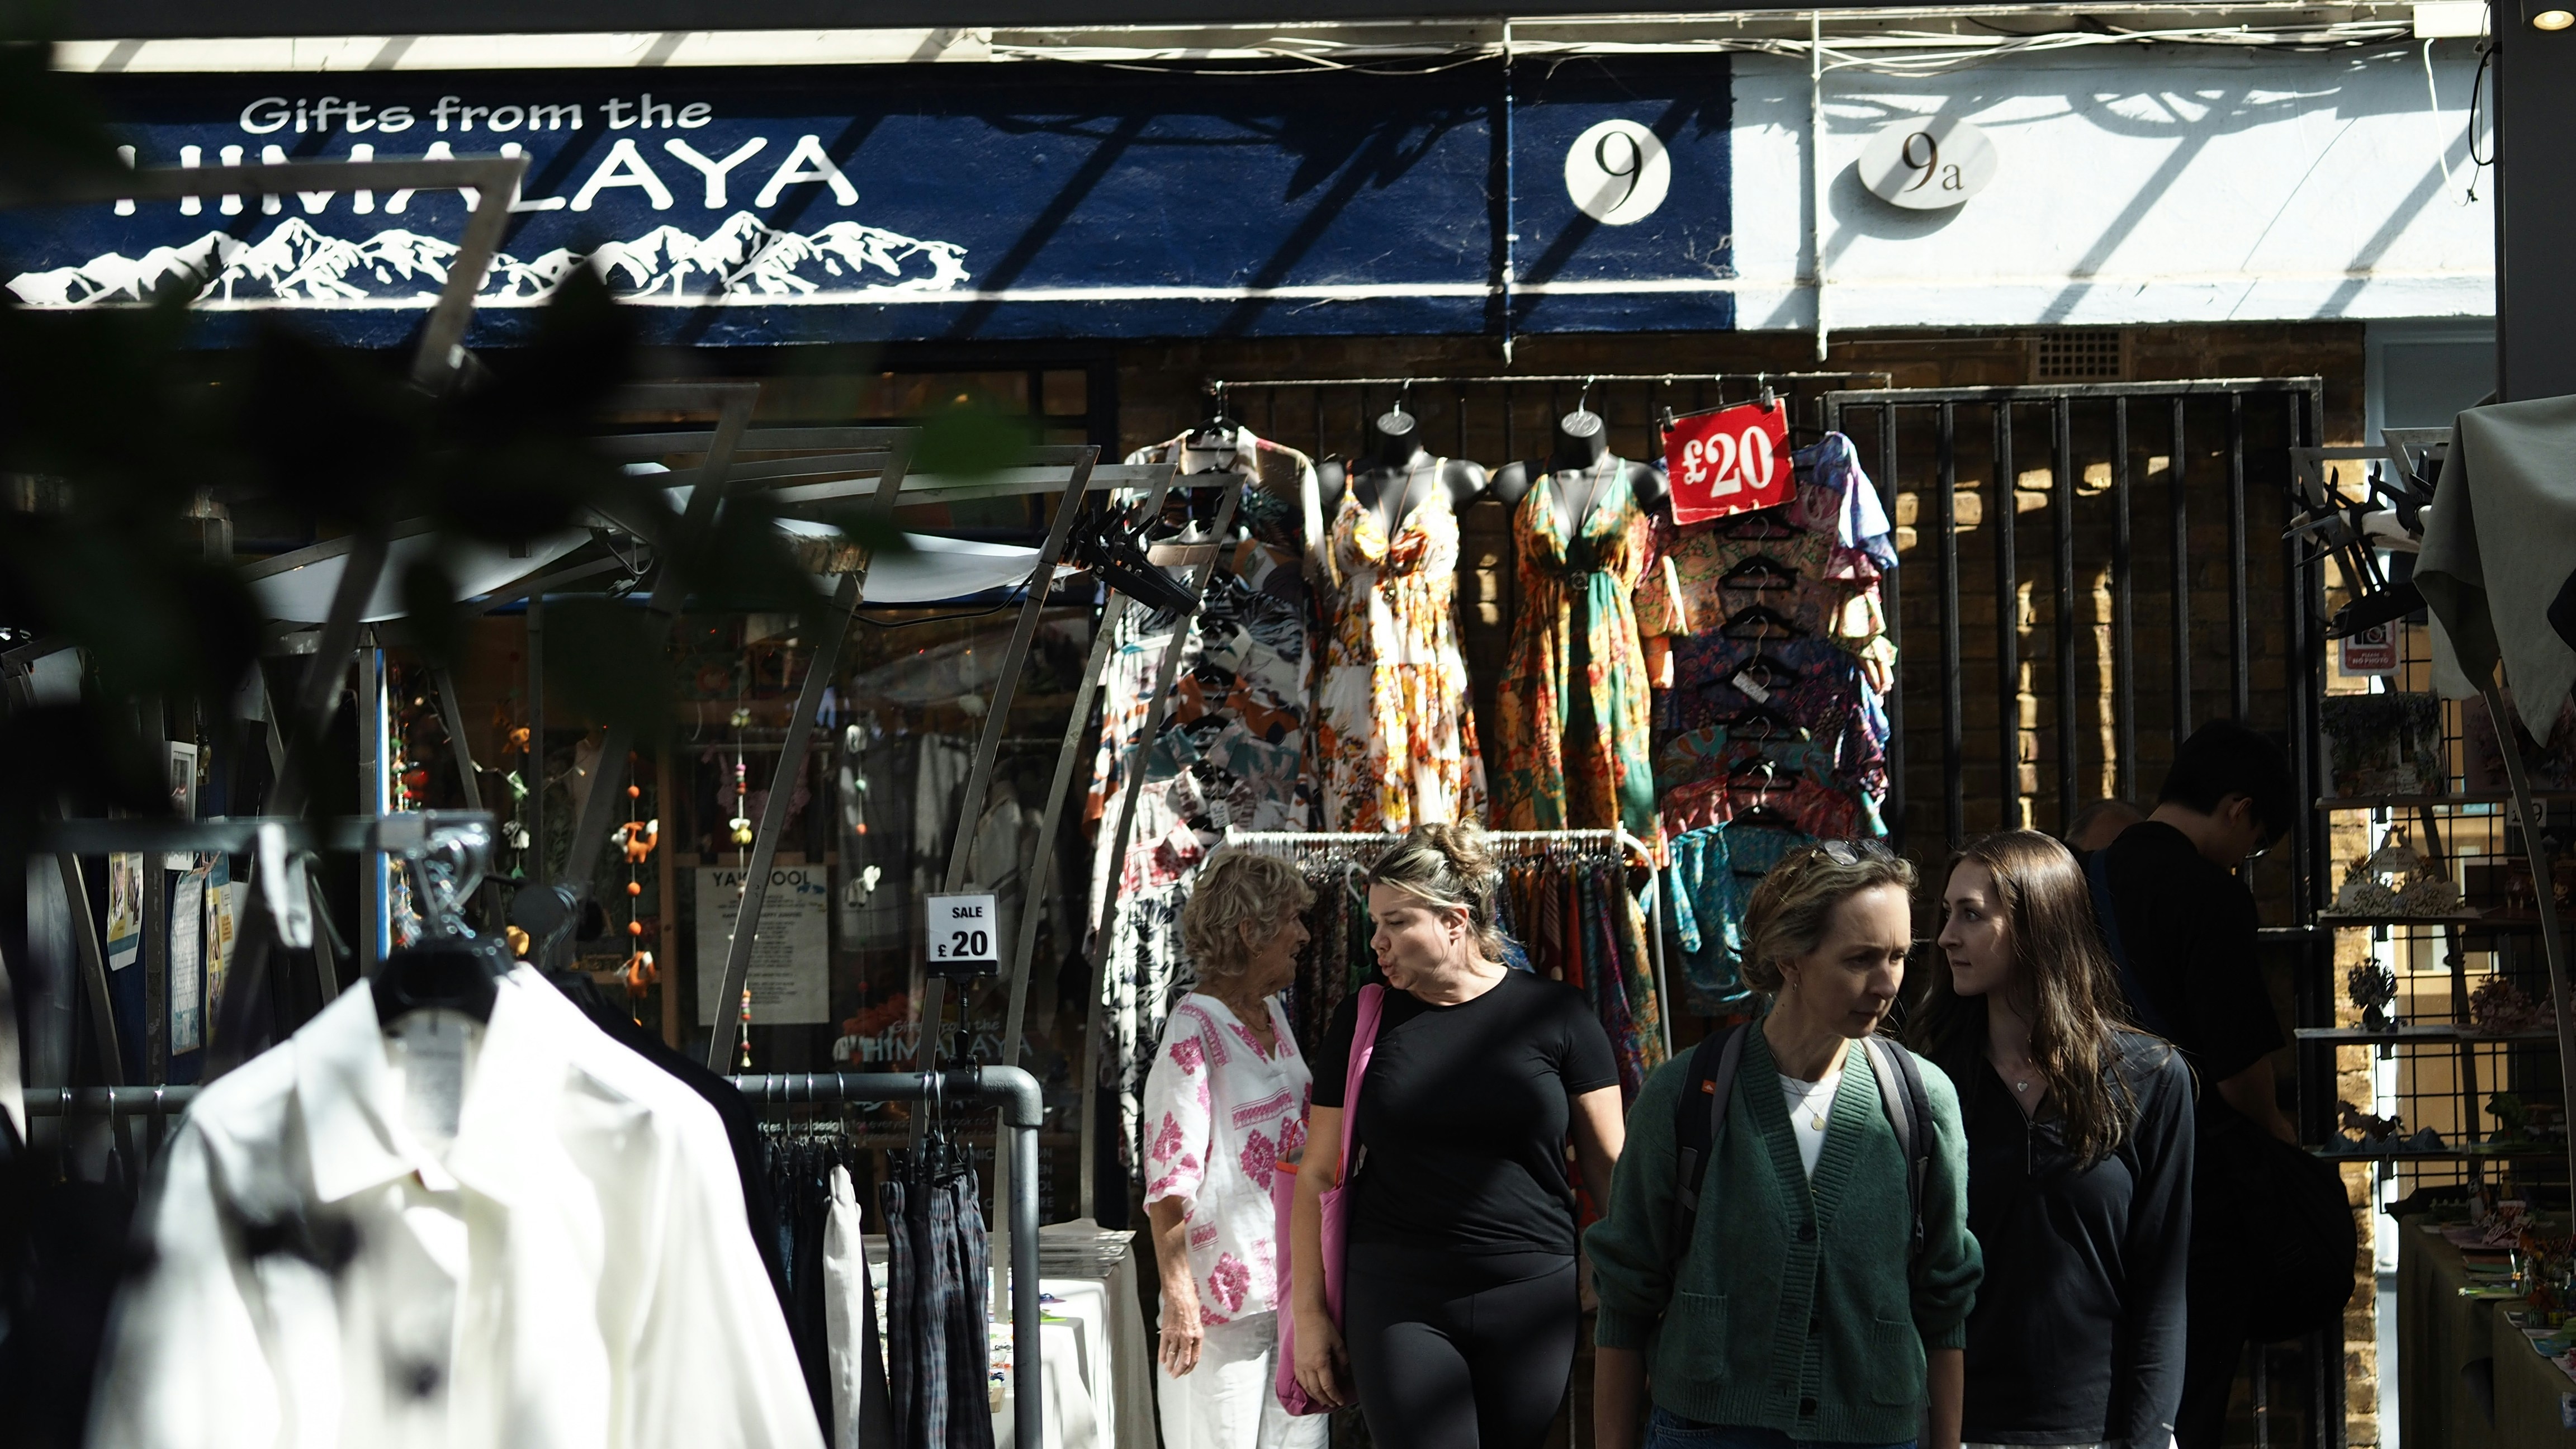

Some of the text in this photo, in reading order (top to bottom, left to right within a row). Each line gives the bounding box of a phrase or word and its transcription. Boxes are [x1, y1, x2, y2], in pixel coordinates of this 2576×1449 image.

[239, 93, 713, 134] Gifts from the
[1595, 131, 1642, 214] 9
[1902, 131, 1964, 192] 9a
[1682, 425, 1775, 499] £20
[952, 906, 983, 918] SALE
[937, 930, 988, 957] £ 20
